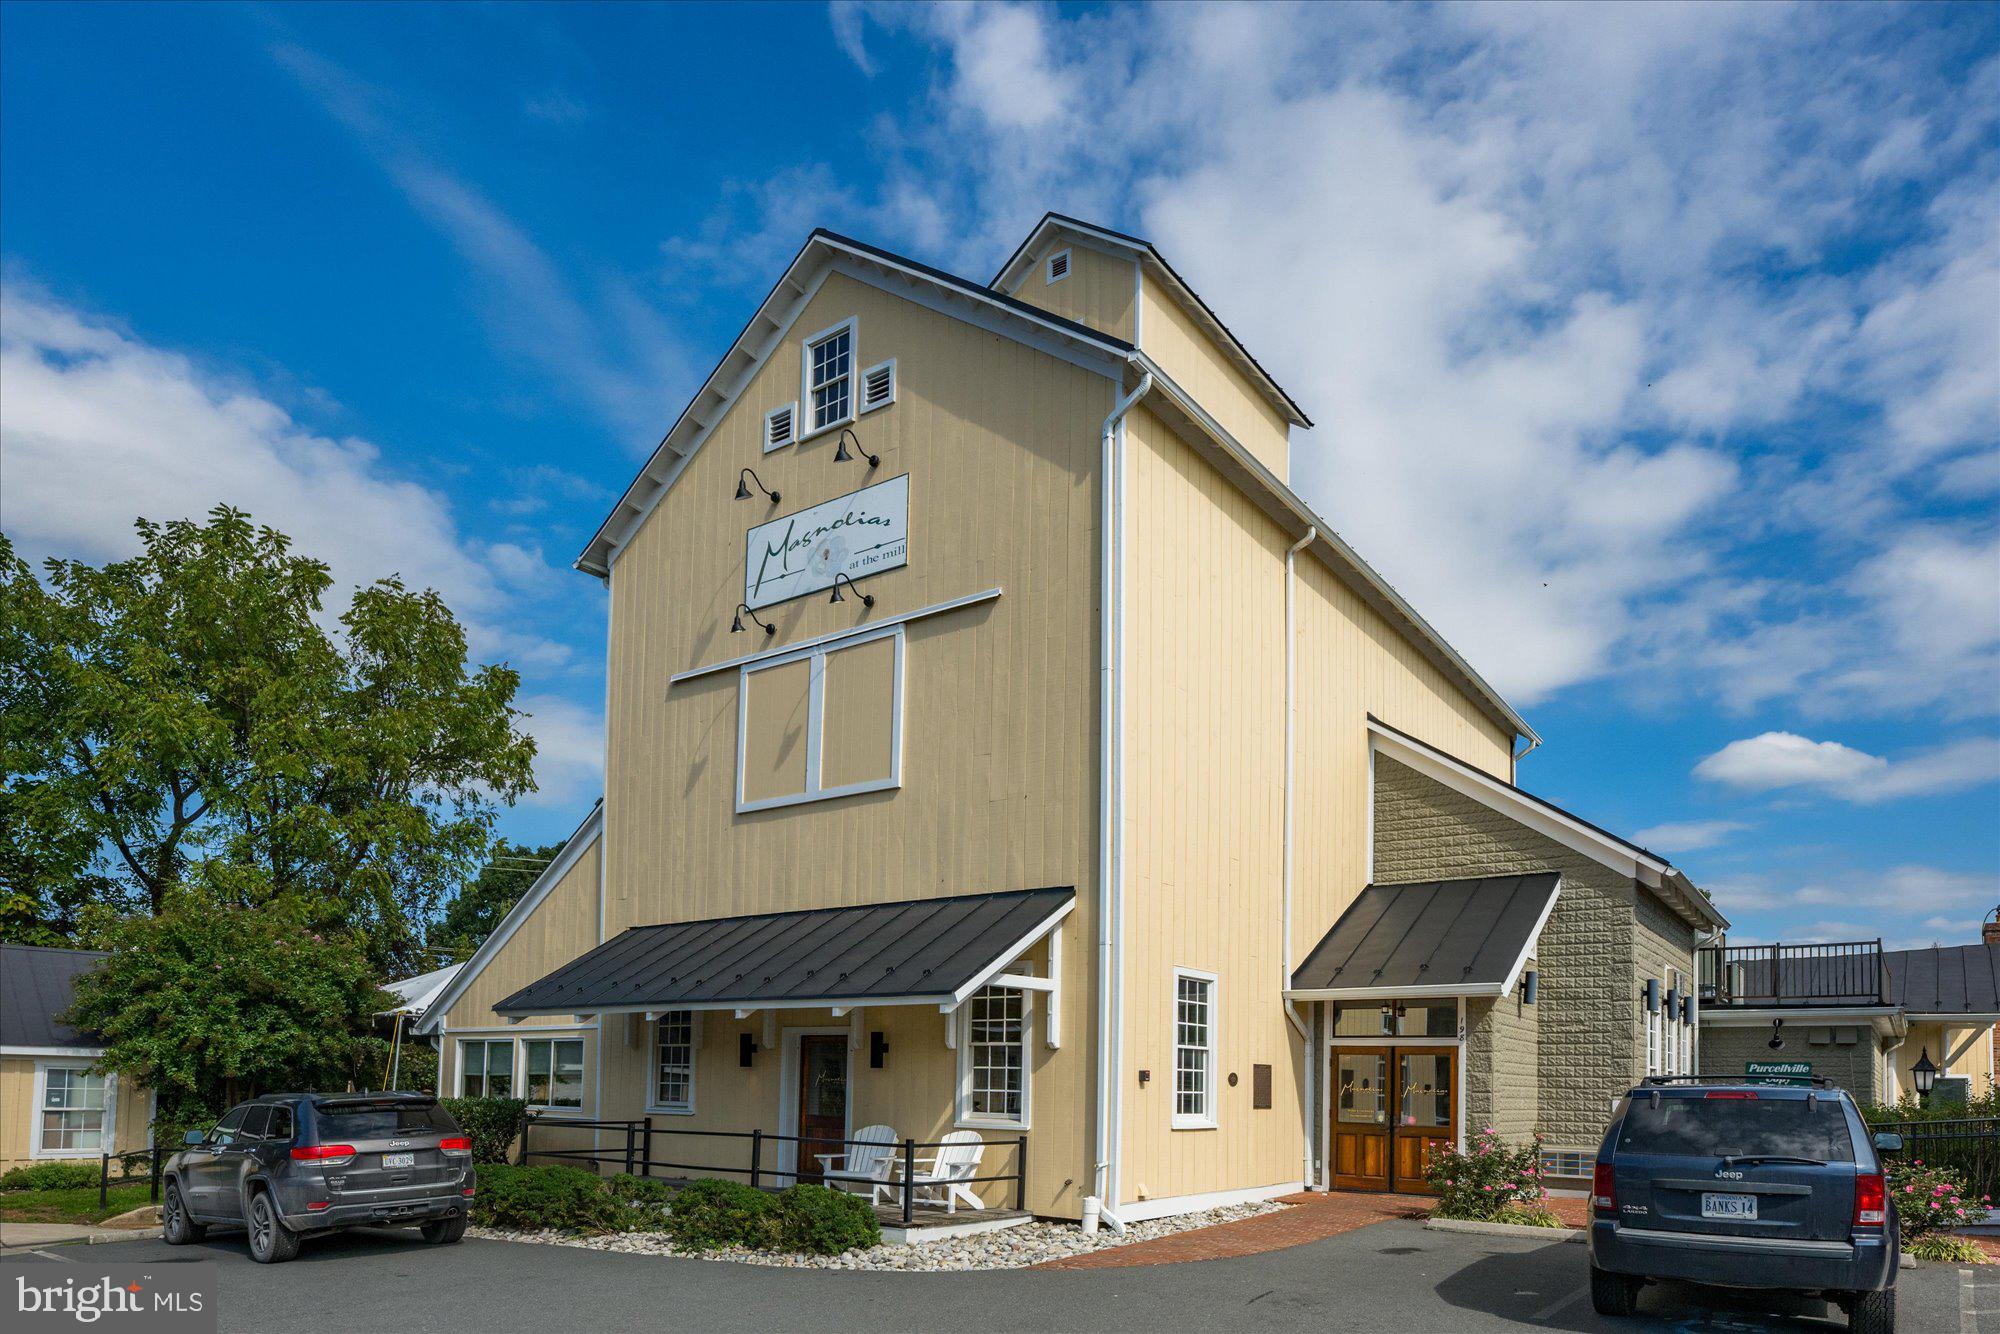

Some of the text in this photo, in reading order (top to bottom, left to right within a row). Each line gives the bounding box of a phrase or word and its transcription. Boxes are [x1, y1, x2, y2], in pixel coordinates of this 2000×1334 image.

[753, 511, 891, 599] Magnolias
[849, 545, 905, 570] at the mill
[1749, 1063, 1810, 1073] Purcellville
[1714, 1169, 1743, 1180] Jeep
[1705, 1199, 1754, 1214] BANKS 14
